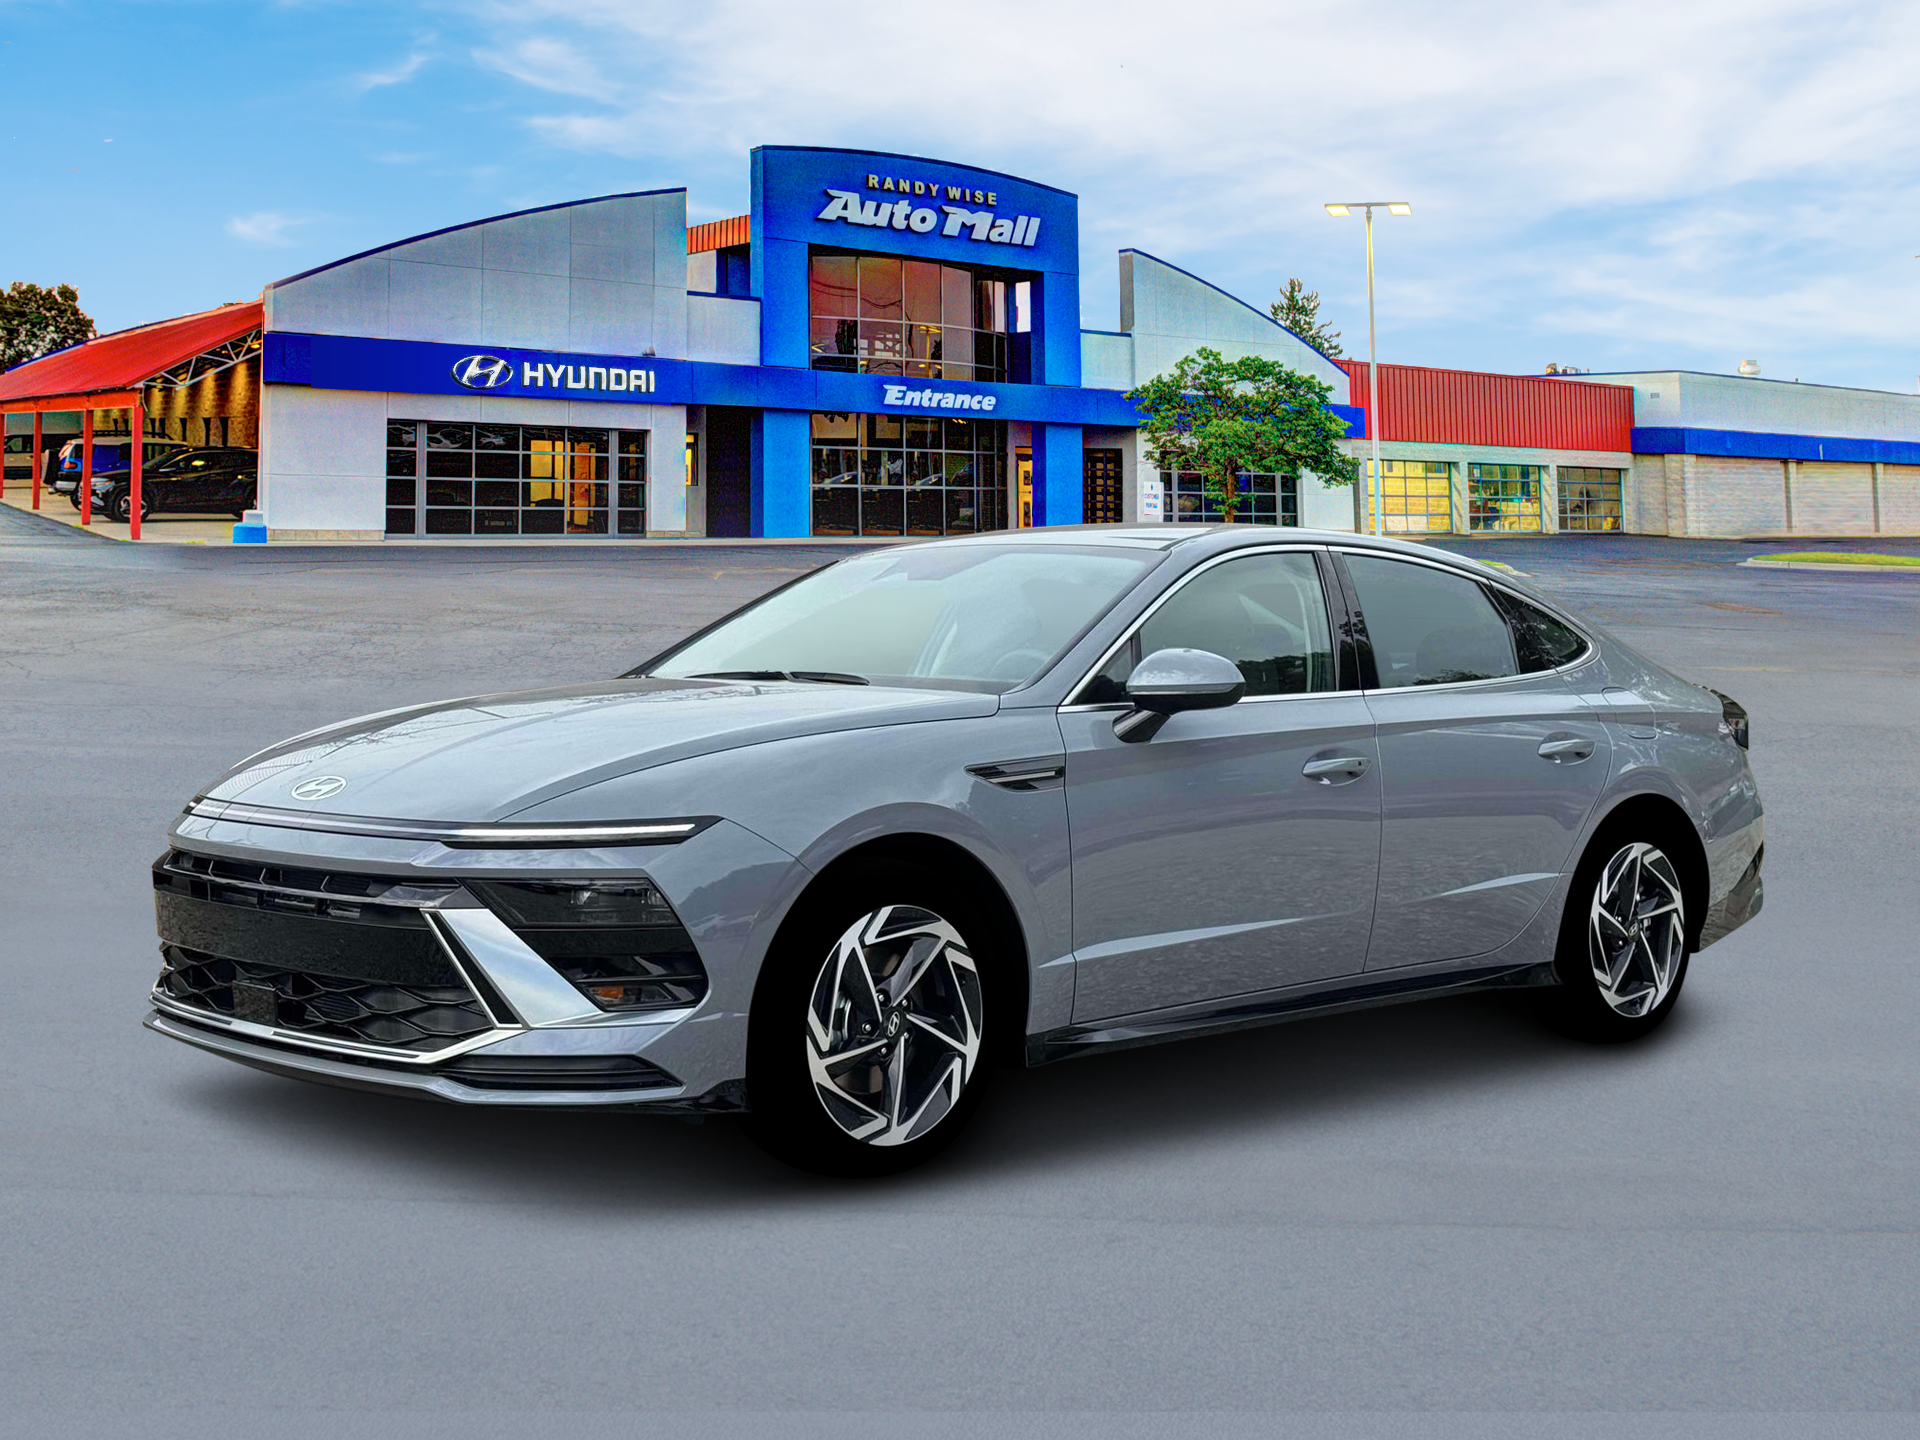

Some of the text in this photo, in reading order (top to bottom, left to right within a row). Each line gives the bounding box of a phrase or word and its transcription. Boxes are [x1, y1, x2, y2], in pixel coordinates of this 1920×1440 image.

[866, 173, 998, 206] RANDY WISE
[816, 188, 1041, 247] Auto Mall
[521, 361, 656, 394] HYUNDAI
[882, 384, 997, 411] Entrance
